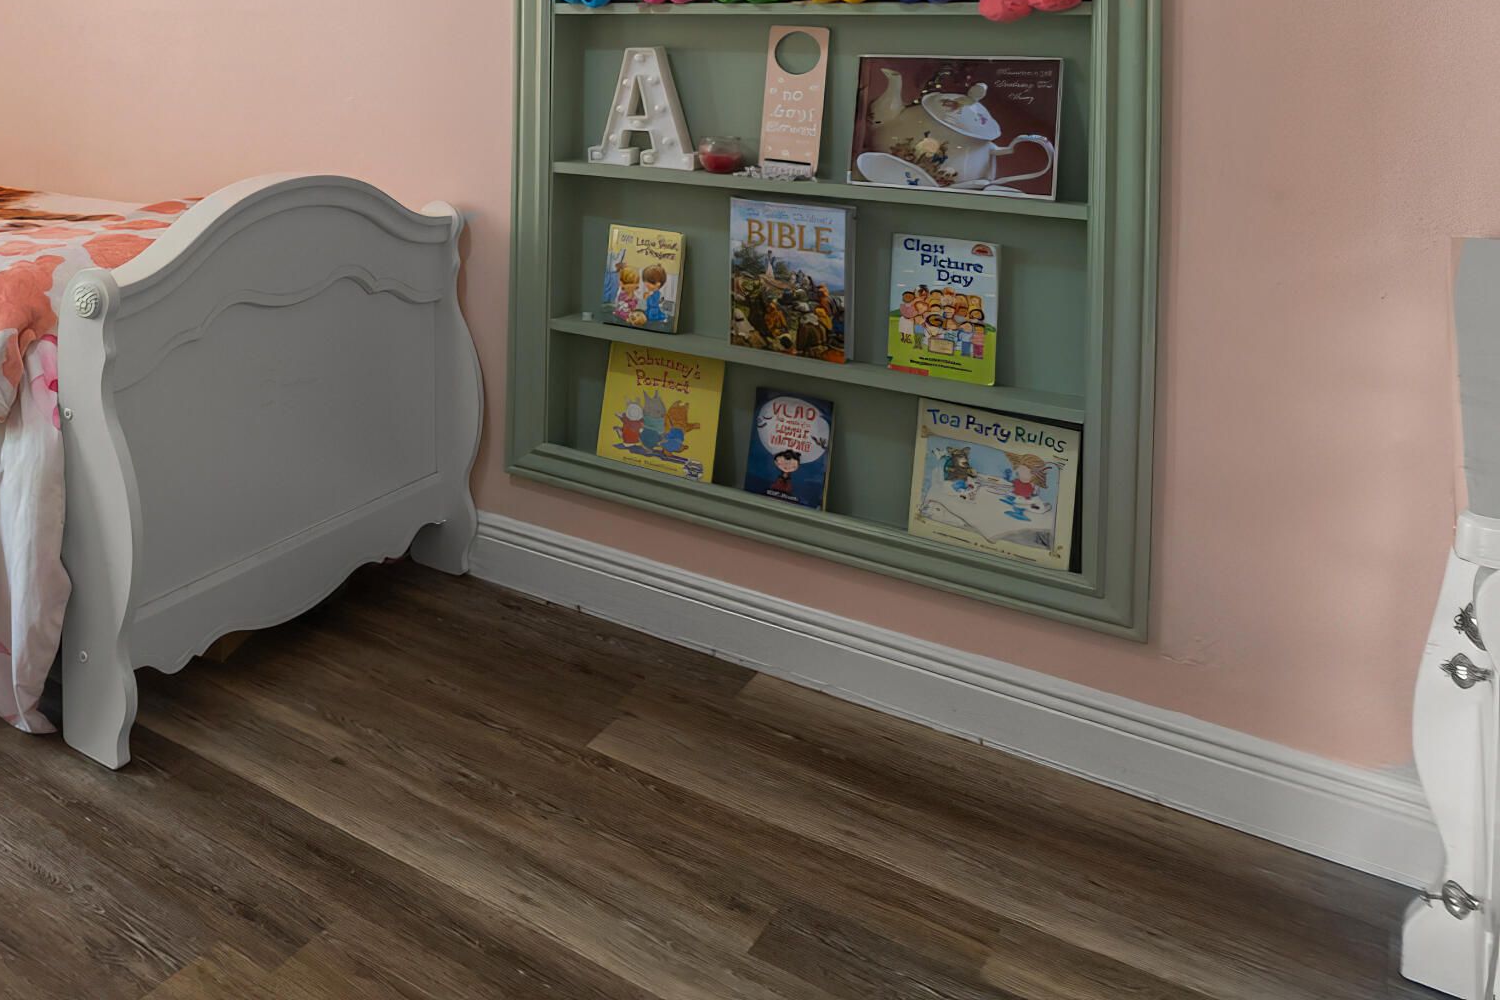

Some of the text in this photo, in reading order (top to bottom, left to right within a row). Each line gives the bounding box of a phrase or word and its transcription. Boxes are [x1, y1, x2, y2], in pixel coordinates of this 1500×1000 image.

[588, 46, 700, 171] A
[746, 218, 833, 255] BIBLE
[920, 253, 984, 274] Picture
[936, 269, 974, 288] Day
